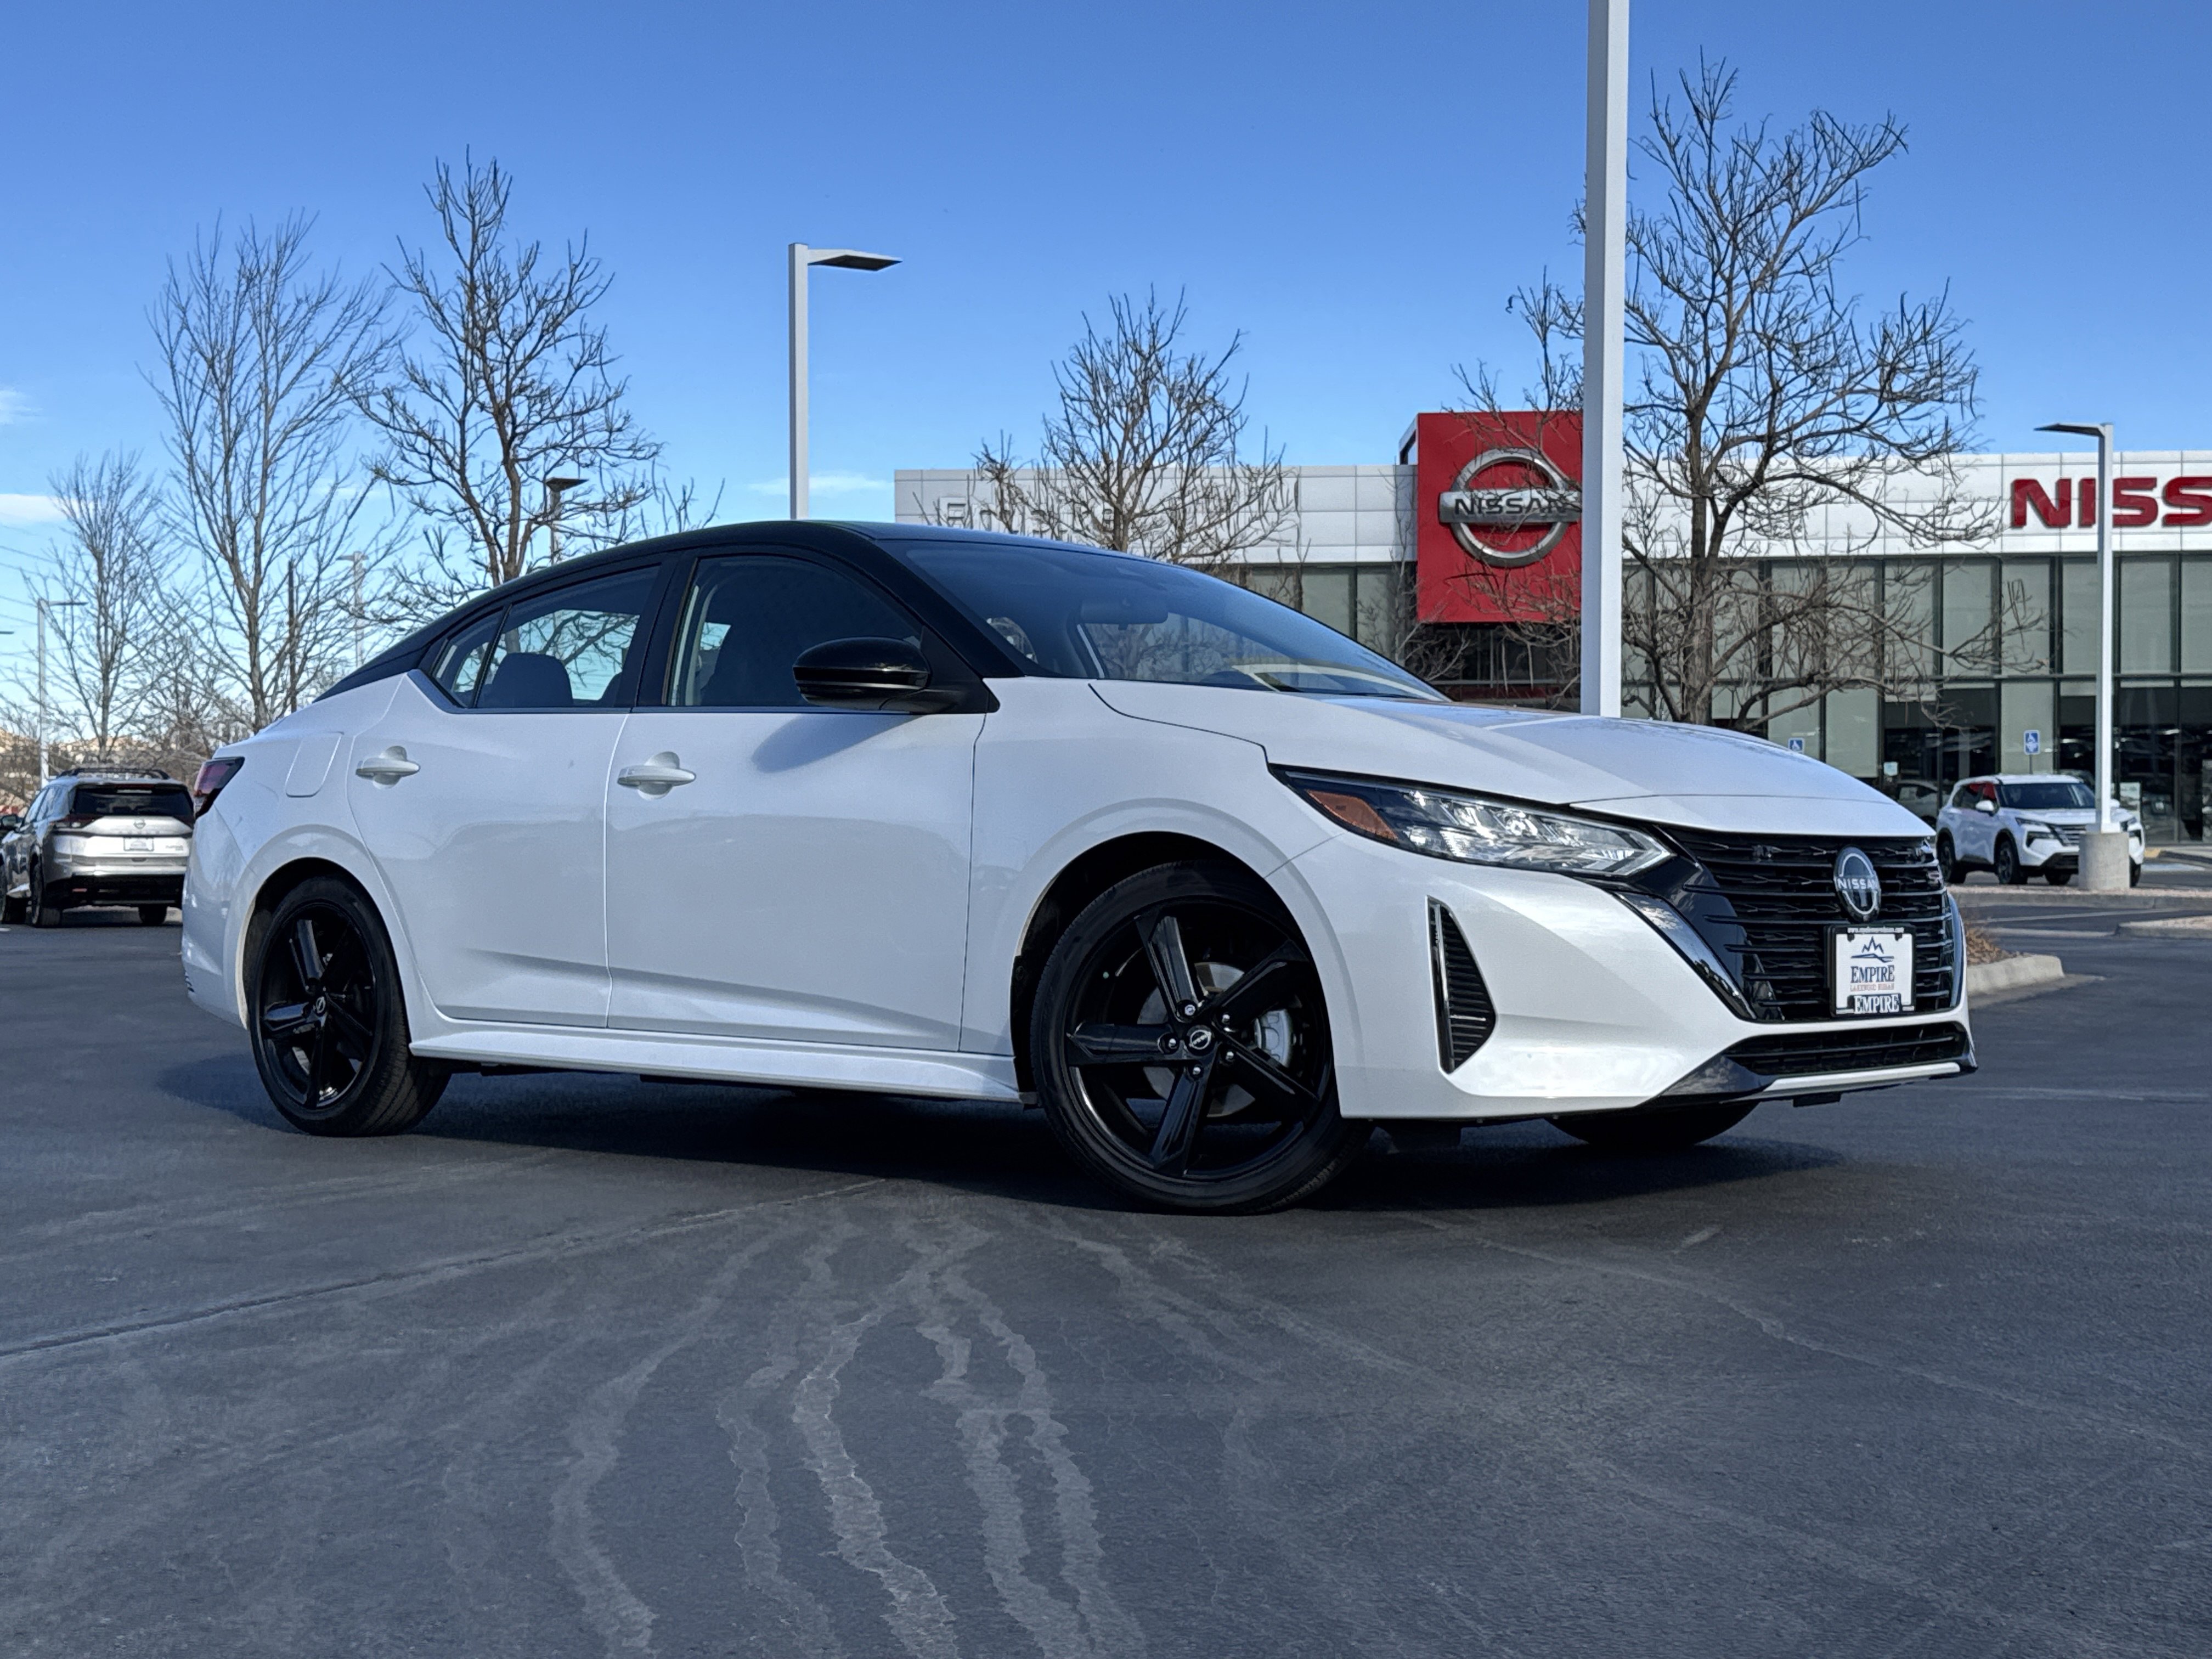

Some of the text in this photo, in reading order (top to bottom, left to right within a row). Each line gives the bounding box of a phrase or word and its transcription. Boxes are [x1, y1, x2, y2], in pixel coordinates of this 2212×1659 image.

[1454, 497, 1567, 515] NISSAN
[1850, 964, 1895, 984] EMPIRE
[1854, 994, 1900, 1014] EMPIRE
